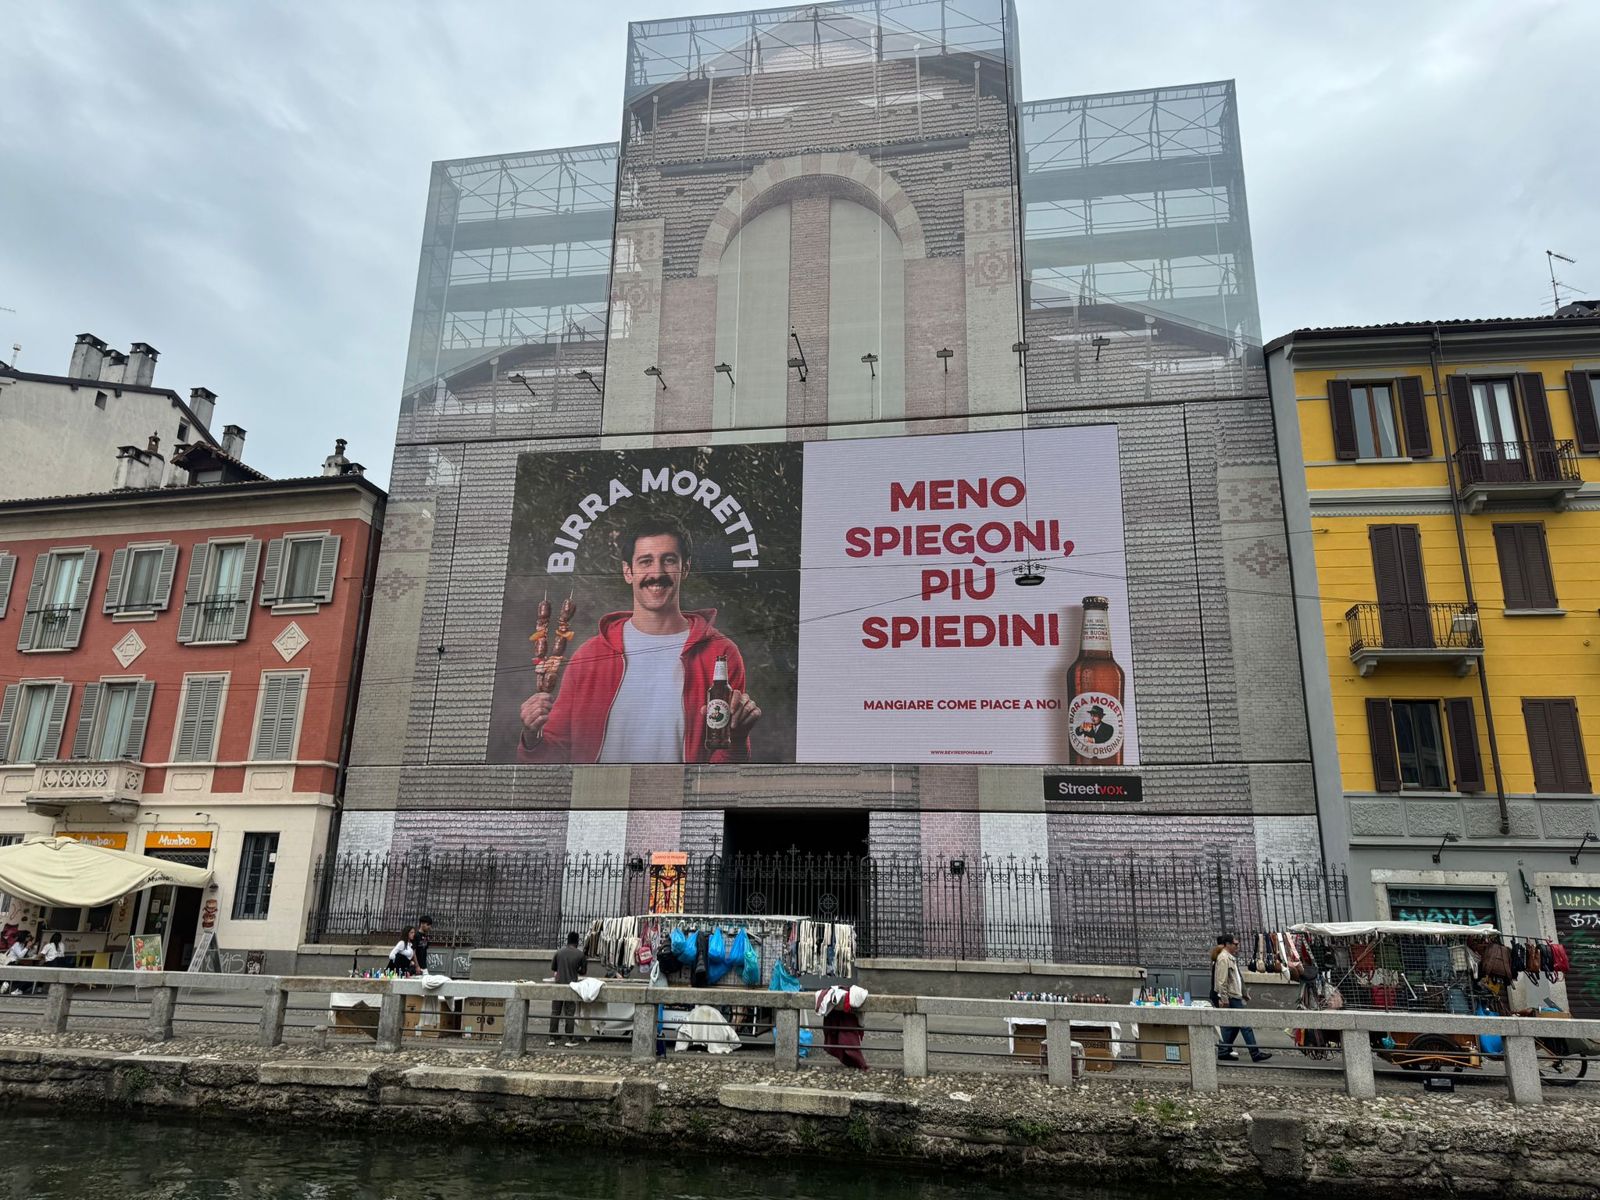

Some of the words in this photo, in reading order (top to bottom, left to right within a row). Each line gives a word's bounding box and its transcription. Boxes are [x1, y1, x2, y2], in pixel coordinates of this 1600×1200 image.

[890, 476, 1025, 512] MENO
[547, 478, 633, 573] BIRRA
[641, 467, 759, 568] MORETTI
[845, 520, 1075, 557] SPIEGONI,
[921, 556, 995, 601] PIÙ
[862, 613, 1060, 649] SPIEDINI
[864, 699, 934, 710] MANGIARE
[937, 699, 977, 710] COME
[980, 699, 1021, 710] PIACE
[1023, 699, 1034, 709] A
[1036, 699, 1062, 709] NOI
[1069, 698, 1088, 724] BIRRA
[1090, 696, 1123, 728] MORETTI
[1058, 782, 1128, 796] Streetvox.
[79, 835, 115, 846] Mumbao
[158, 834, 197, 846] Mumbao
